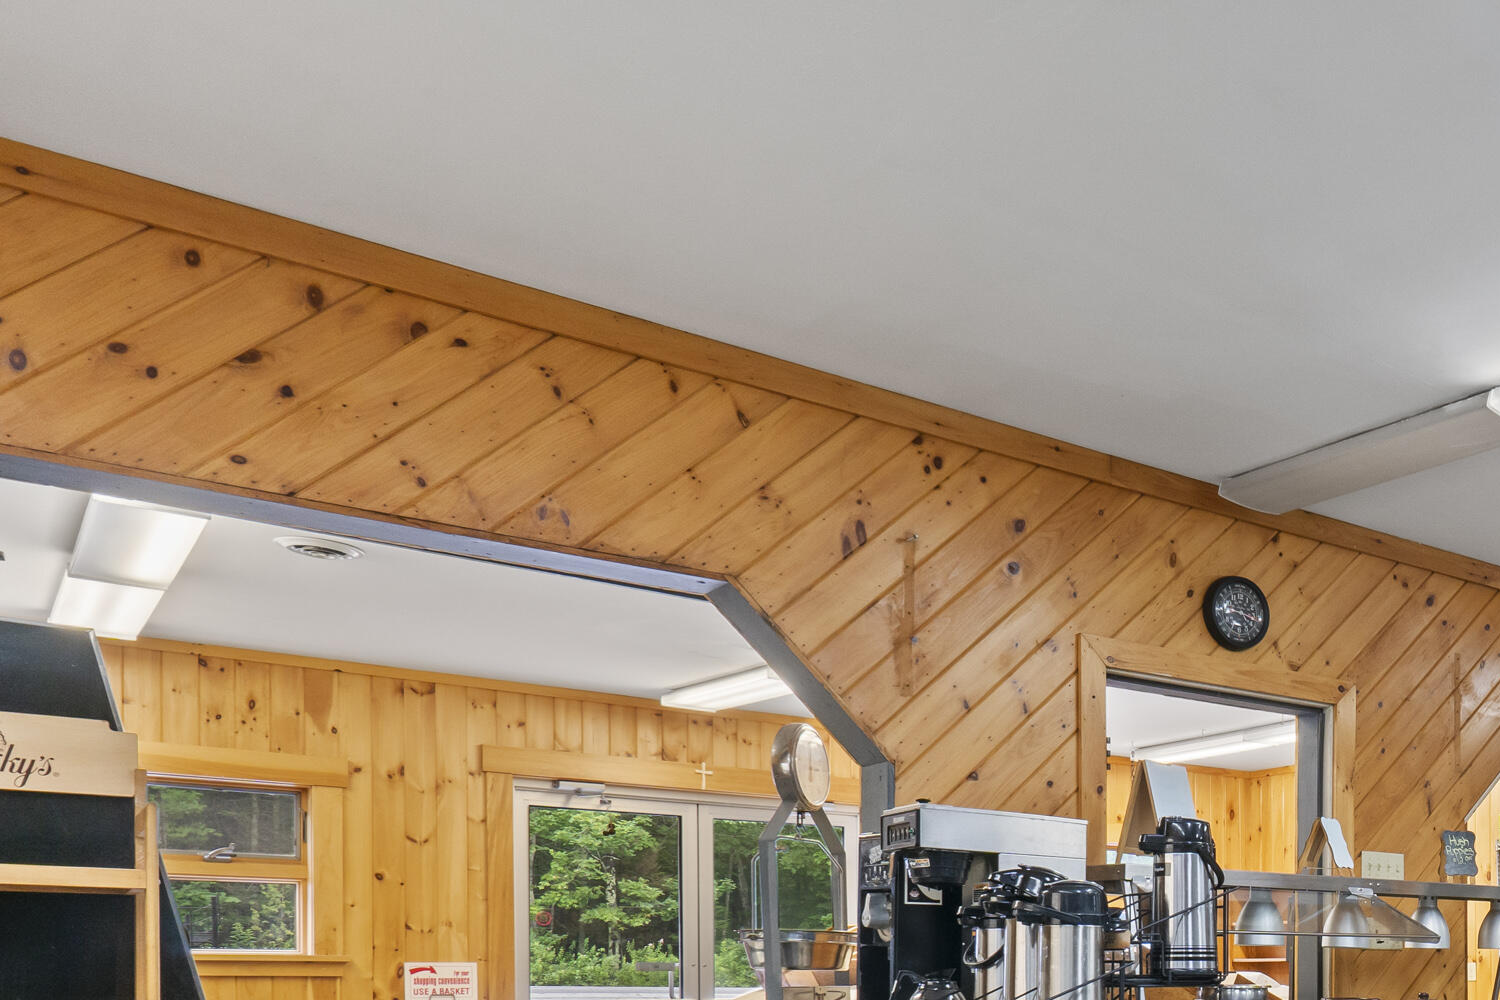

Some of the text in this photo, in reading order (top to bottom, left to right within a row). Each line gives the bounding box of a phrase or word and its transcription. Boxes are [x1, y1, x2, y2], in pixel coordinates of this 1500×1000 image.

[0, 744, 54, 787] ky's
[1448, 835, 1470, 847] Hush
[413, 976, 470, 986] shopping convenience
[413, 987, 469, 996] USE A BASKET
